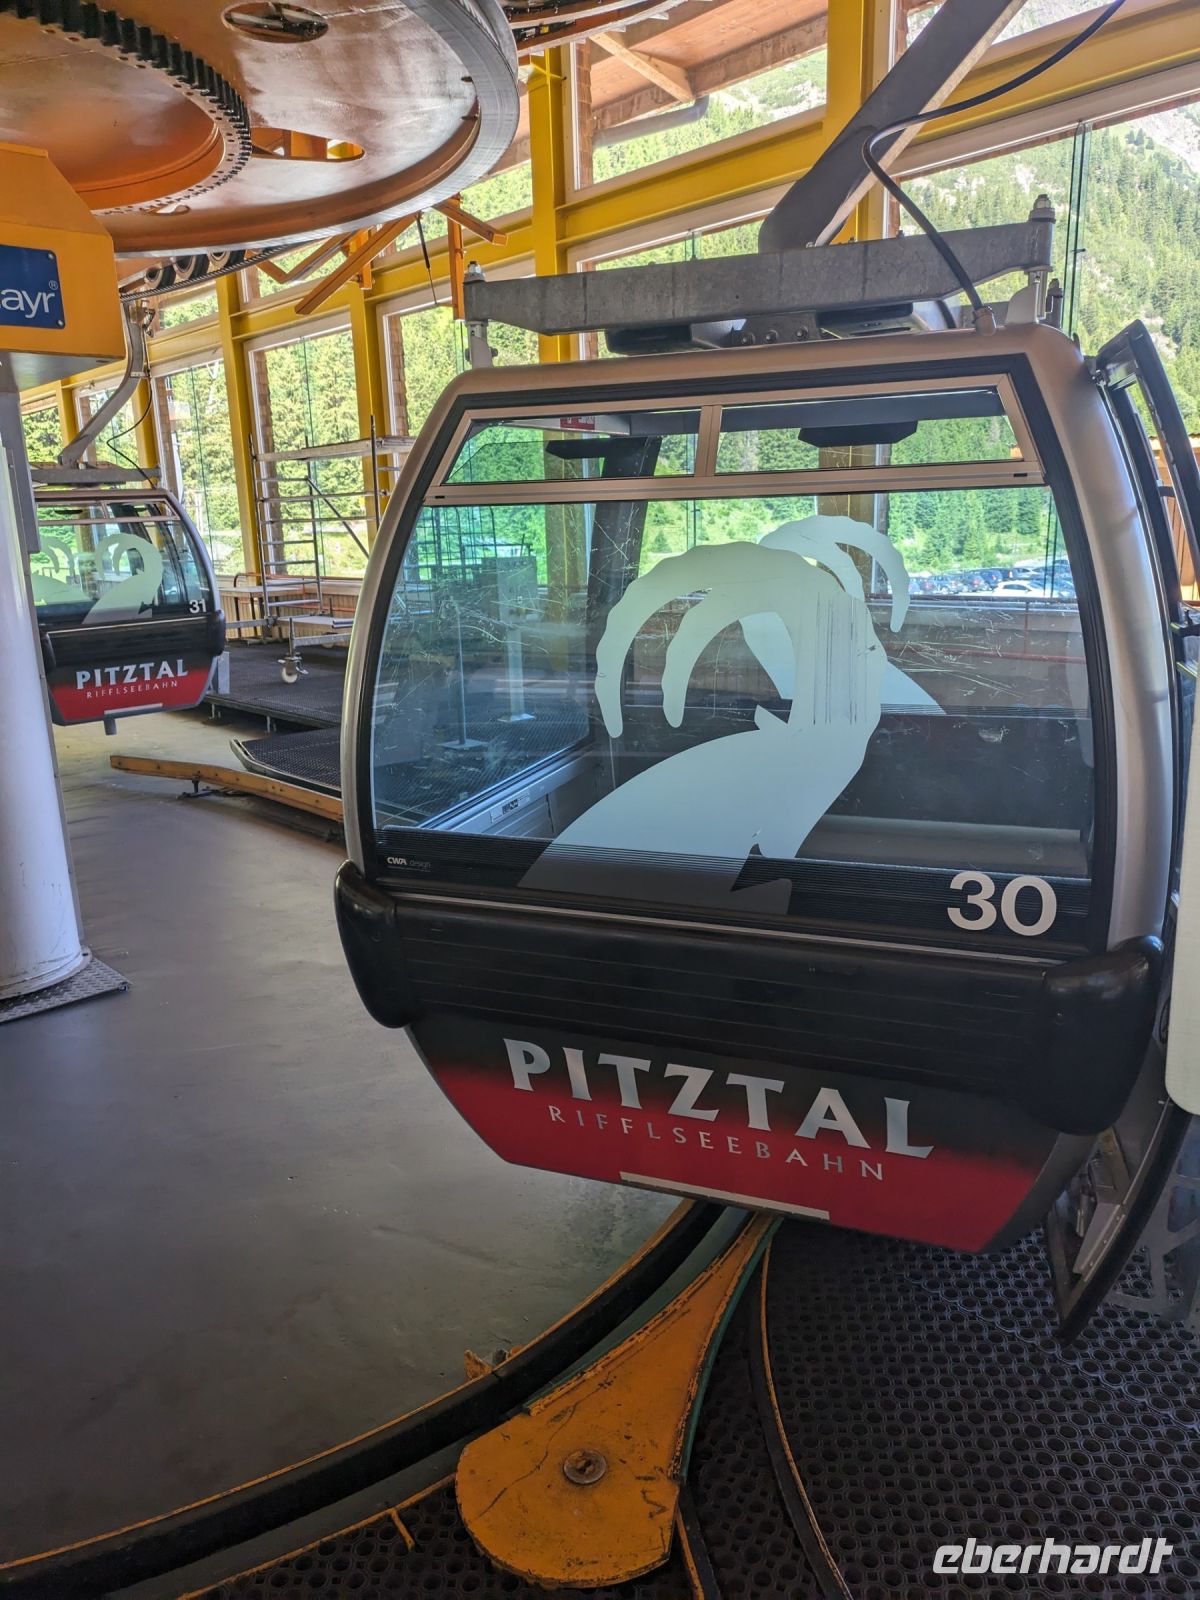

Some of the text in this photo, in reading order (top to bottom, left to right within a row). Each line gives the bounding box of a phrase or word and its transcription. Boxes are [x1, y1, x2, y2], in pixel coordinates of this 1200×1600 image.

[189, 598, 207, 614] 31
[76, 659, 189, 690] PITZTAL
[86, 680, 178, 699] RIFFLSEEBAHN
[386, 856, 408, 866] CWA
[947, 870, 1058, 937] 30
[503, 1038, 934, 1159] PITZTAL
[547, 1104, 884, 1181] RIFFLSEEBAHN
